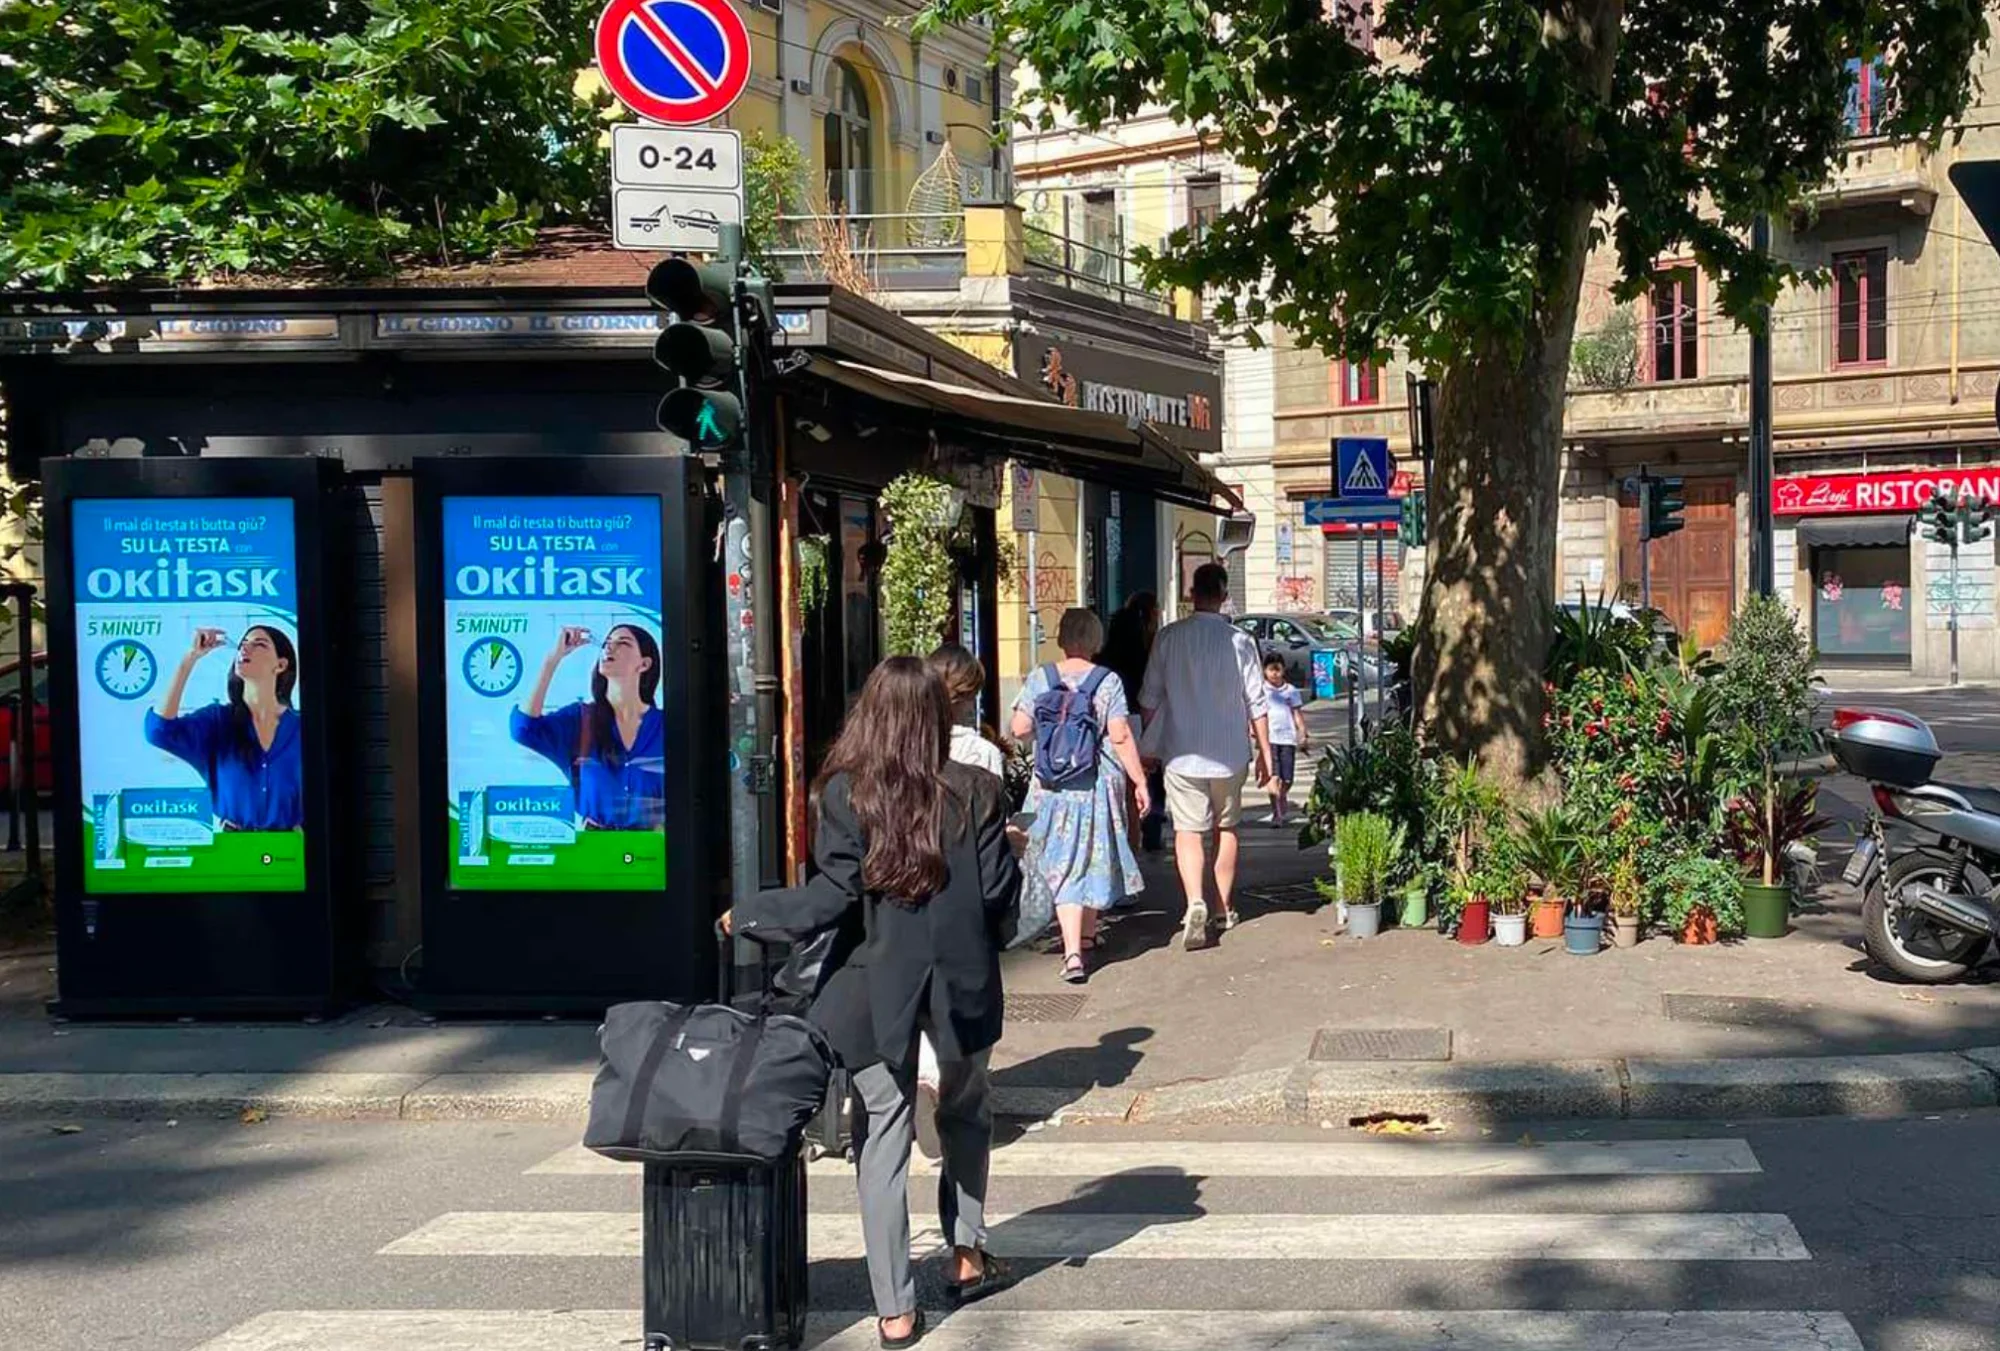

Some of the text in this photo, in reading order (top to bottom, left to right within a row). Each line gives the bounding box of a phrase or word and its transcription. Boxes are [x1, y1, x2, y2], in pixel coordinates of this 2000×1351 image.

[639, 145, 717, 171] 0-24
[384, 315, 513, 332] IL GIORNO
[529, 315, 556, 331] IL
[1082, 381, 1188, 427] RISTORANTE
[121, 537, 144, 553] SU
[149, 537, 171, 553] LA
[175, 537, 230, 553] TESTA
[490, 535, 513, 551] SU
[516, 535, 539, 551] LA
[542, 535, 596, 551] TESTA
[87, 621, 162, 636] 5 MINUTI
[455, 618, 528, 633] 5 MINUTI
